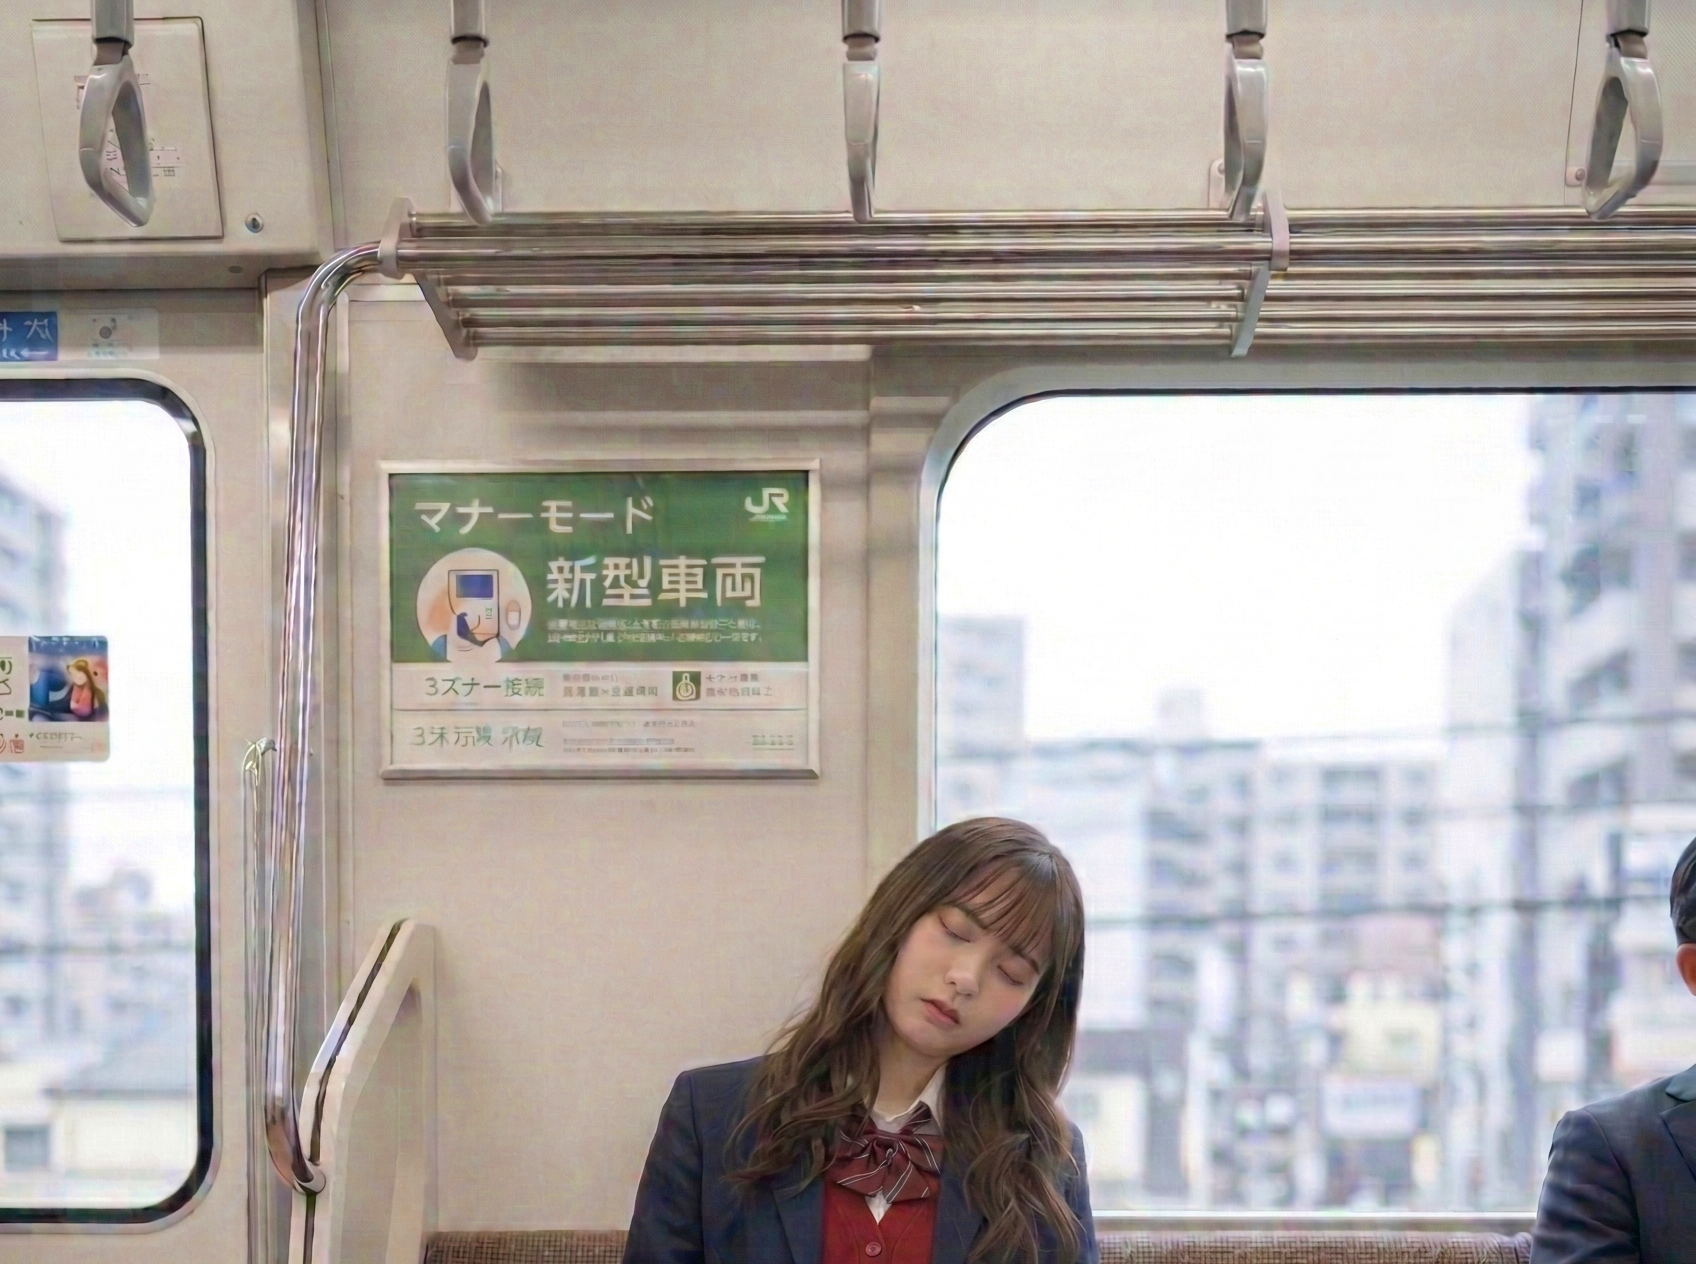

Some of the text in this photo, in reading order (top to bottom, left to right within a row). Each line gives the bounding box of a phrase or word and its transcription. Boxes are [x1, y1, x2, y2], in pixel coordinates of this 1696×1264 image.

[414, 496, 654, 535] マナーモード
[744, 487, 790, 514] JR
[546, 555, 766, 609] 新型車両
